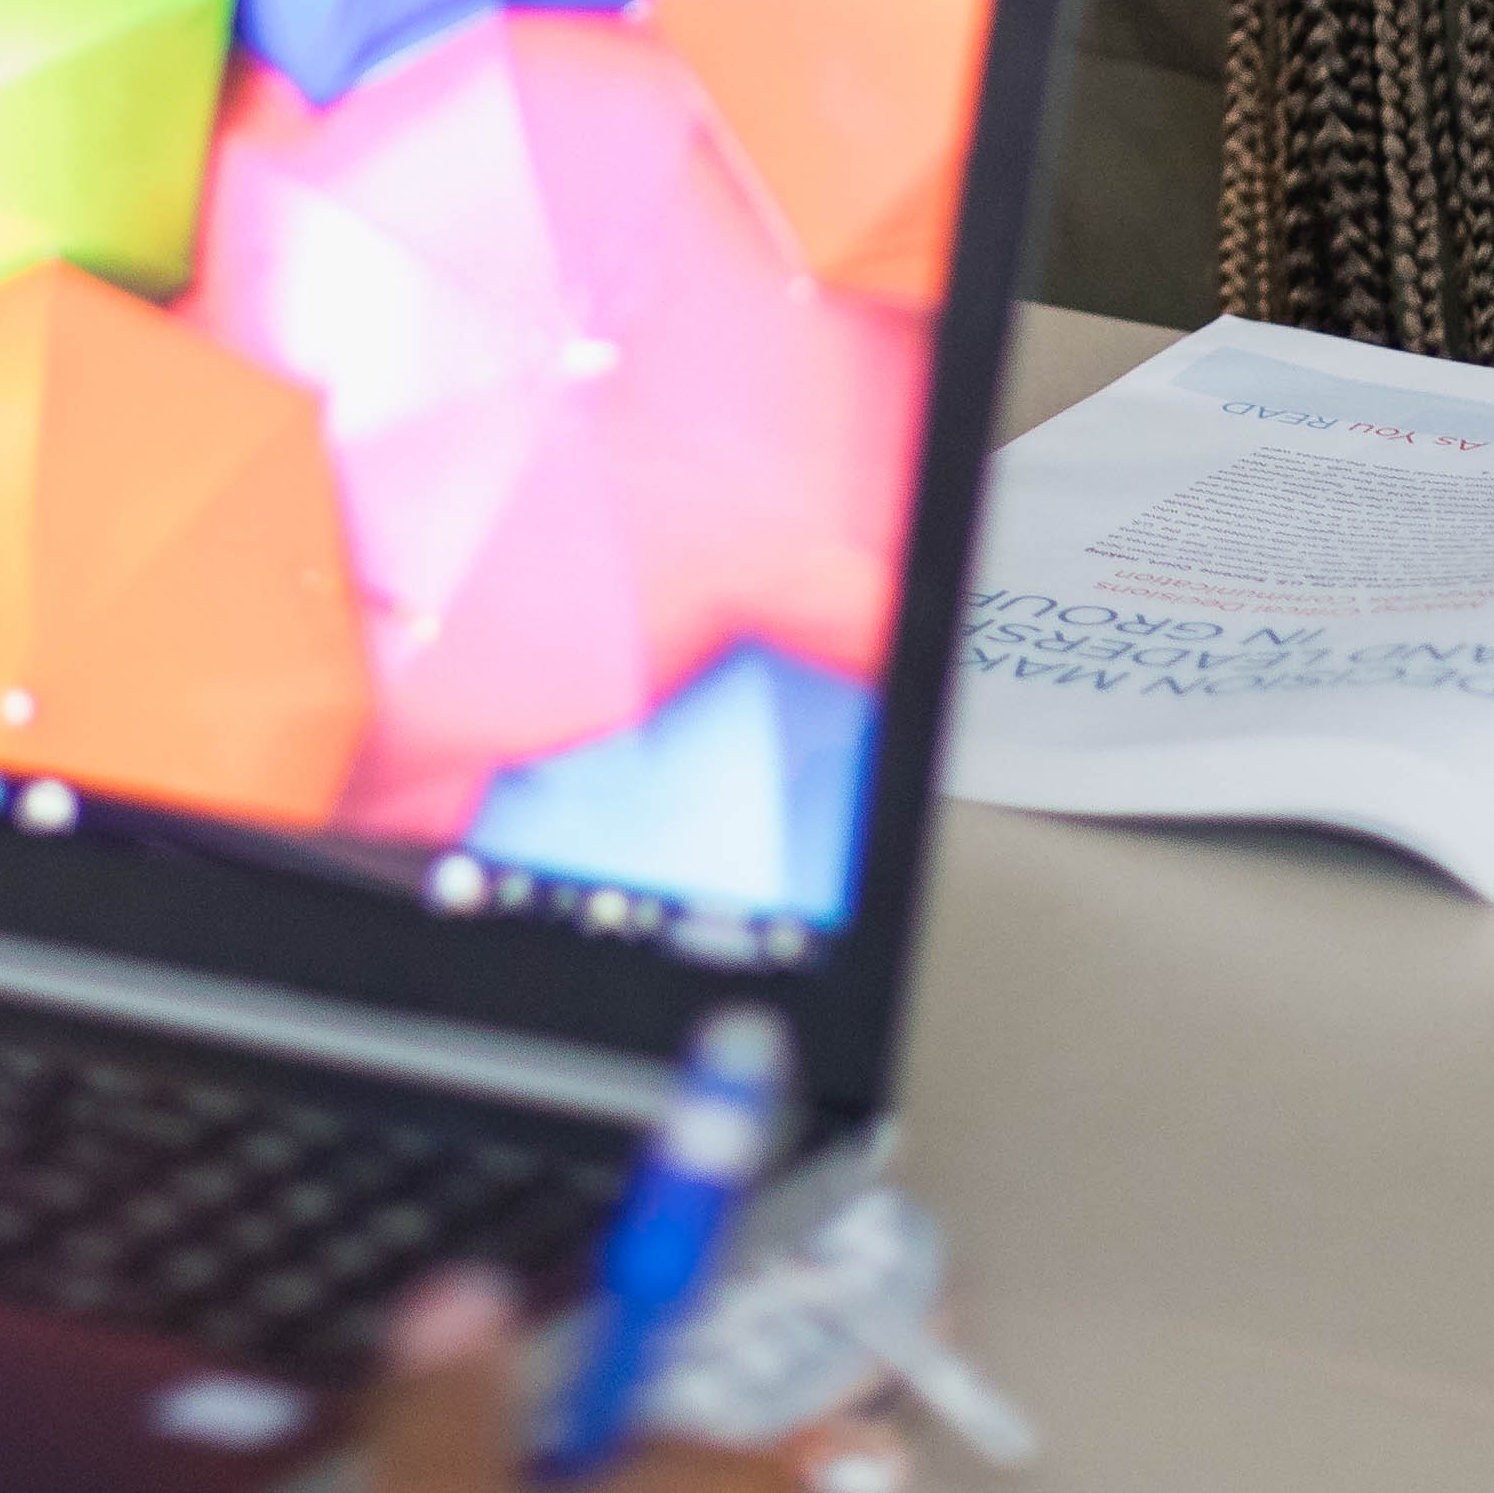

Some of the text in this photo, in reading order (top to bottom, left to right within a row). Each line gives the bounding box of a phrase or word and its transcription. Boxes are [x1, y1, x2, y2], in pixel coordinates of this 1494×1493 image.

[1220, 402, 1339, 430] READ
[1091, 581, 1245, 613] Decisions
[1114, 569, 1357, 605] Communication
[1238, 626, 1323, 647] IN
